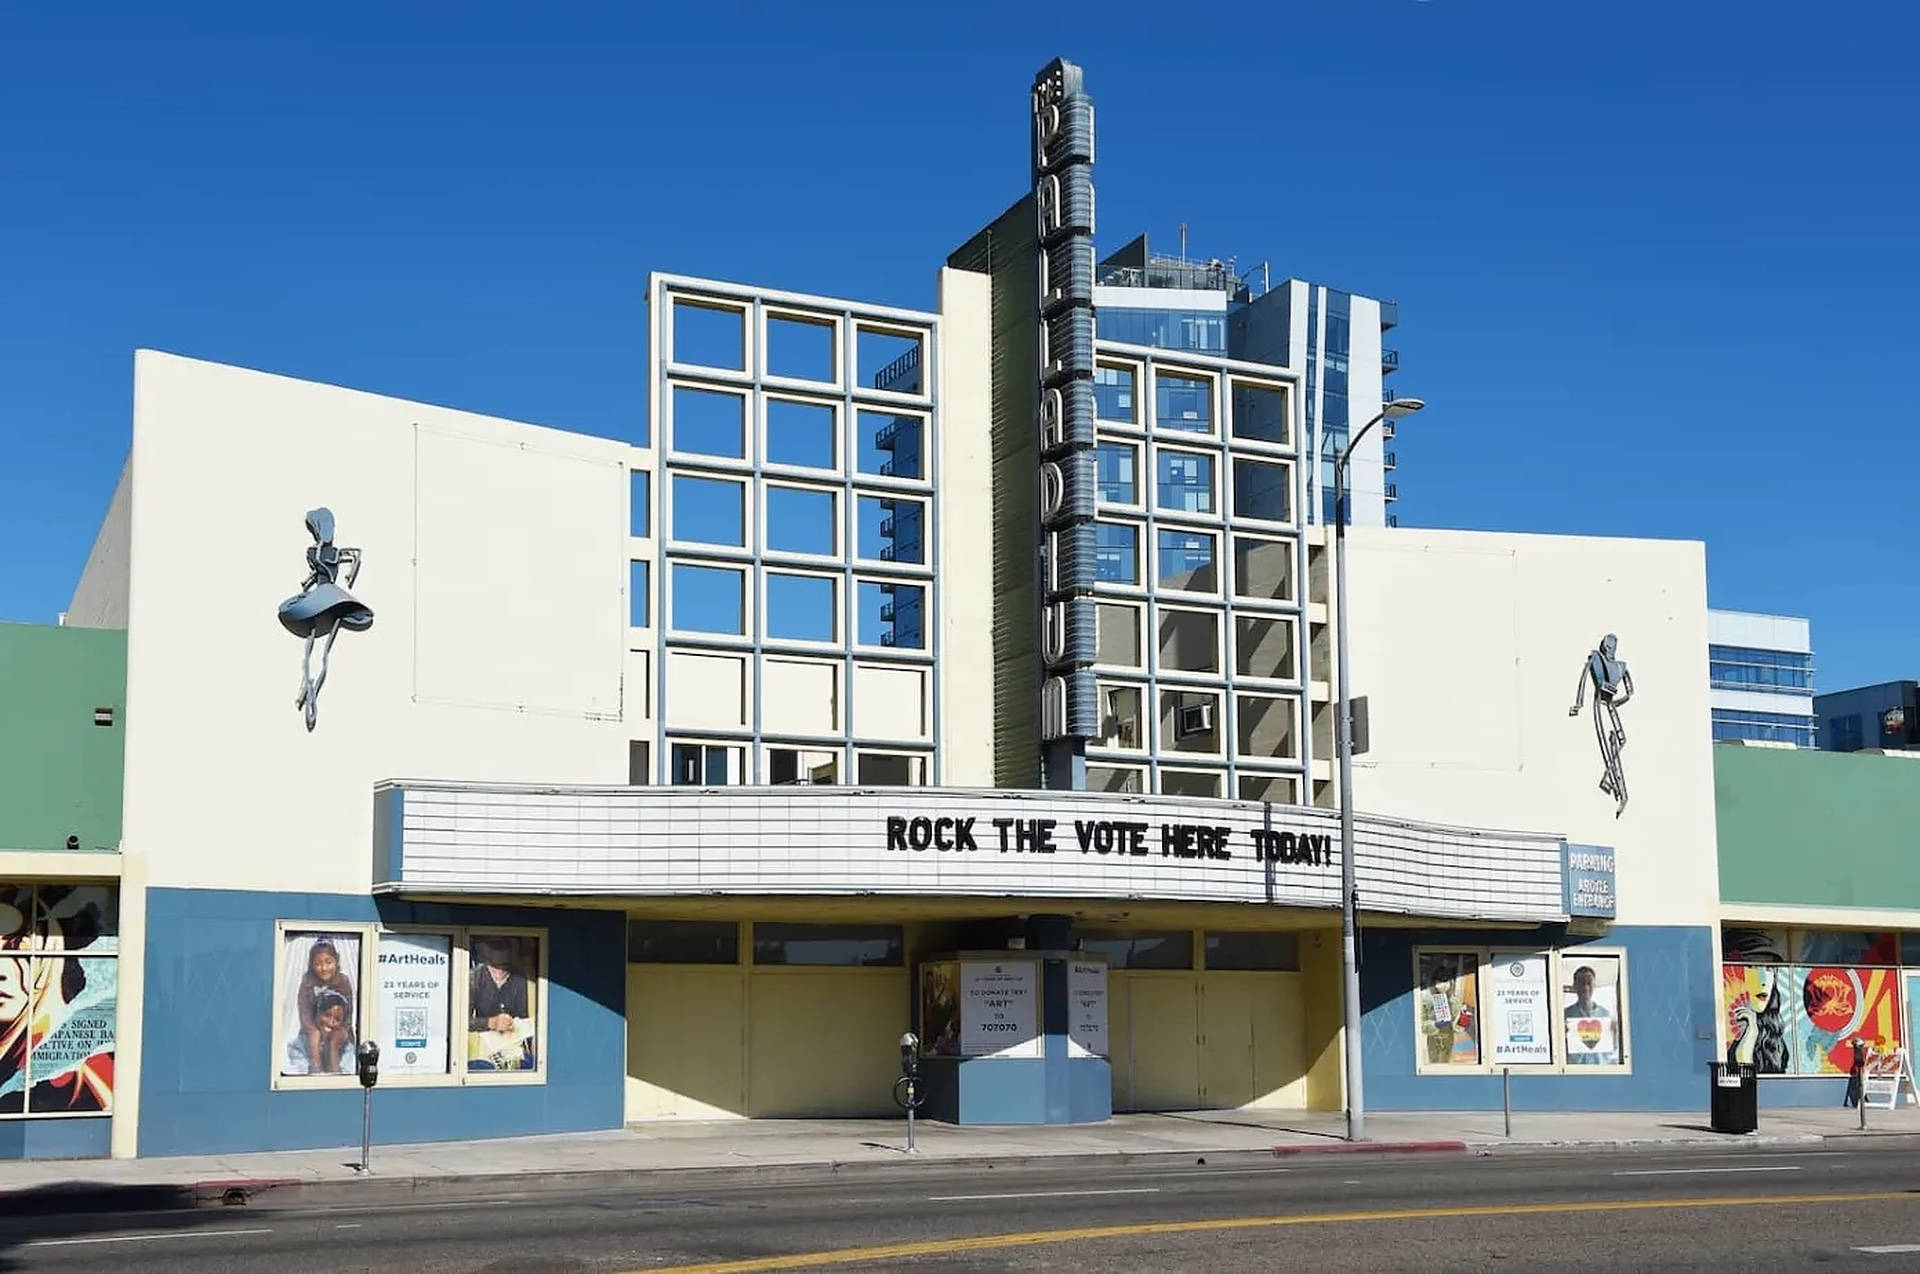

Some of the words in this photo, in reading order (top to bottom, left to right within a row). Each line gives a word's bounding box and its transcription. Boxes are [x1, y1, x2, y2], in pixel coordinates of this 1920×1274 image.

[887, 816, 978, 851] ROCK
[993, 817, 1057, 854] THE
[1075, 819, 1149, 857] VOTE
[1161, 824, 1231, 861] HERE
[1250, 829, 1331, 867] TODAY!
[1569, 853, 1615, 873] PARKING
[378, 953, 446, 966] #ArtHeals
[397, 981, 426, 989] YEARS
[427, 981, 440, 989] OF
[393, 991, 431, 999] SERVICE
[71, 1019, 108, 1029] SIGNED
[980, 1023, 1018, 1032] 707070
[77, 1040, 92, 1050] ON
[1496, 1045, 1548, 1055] #ArtHeals
